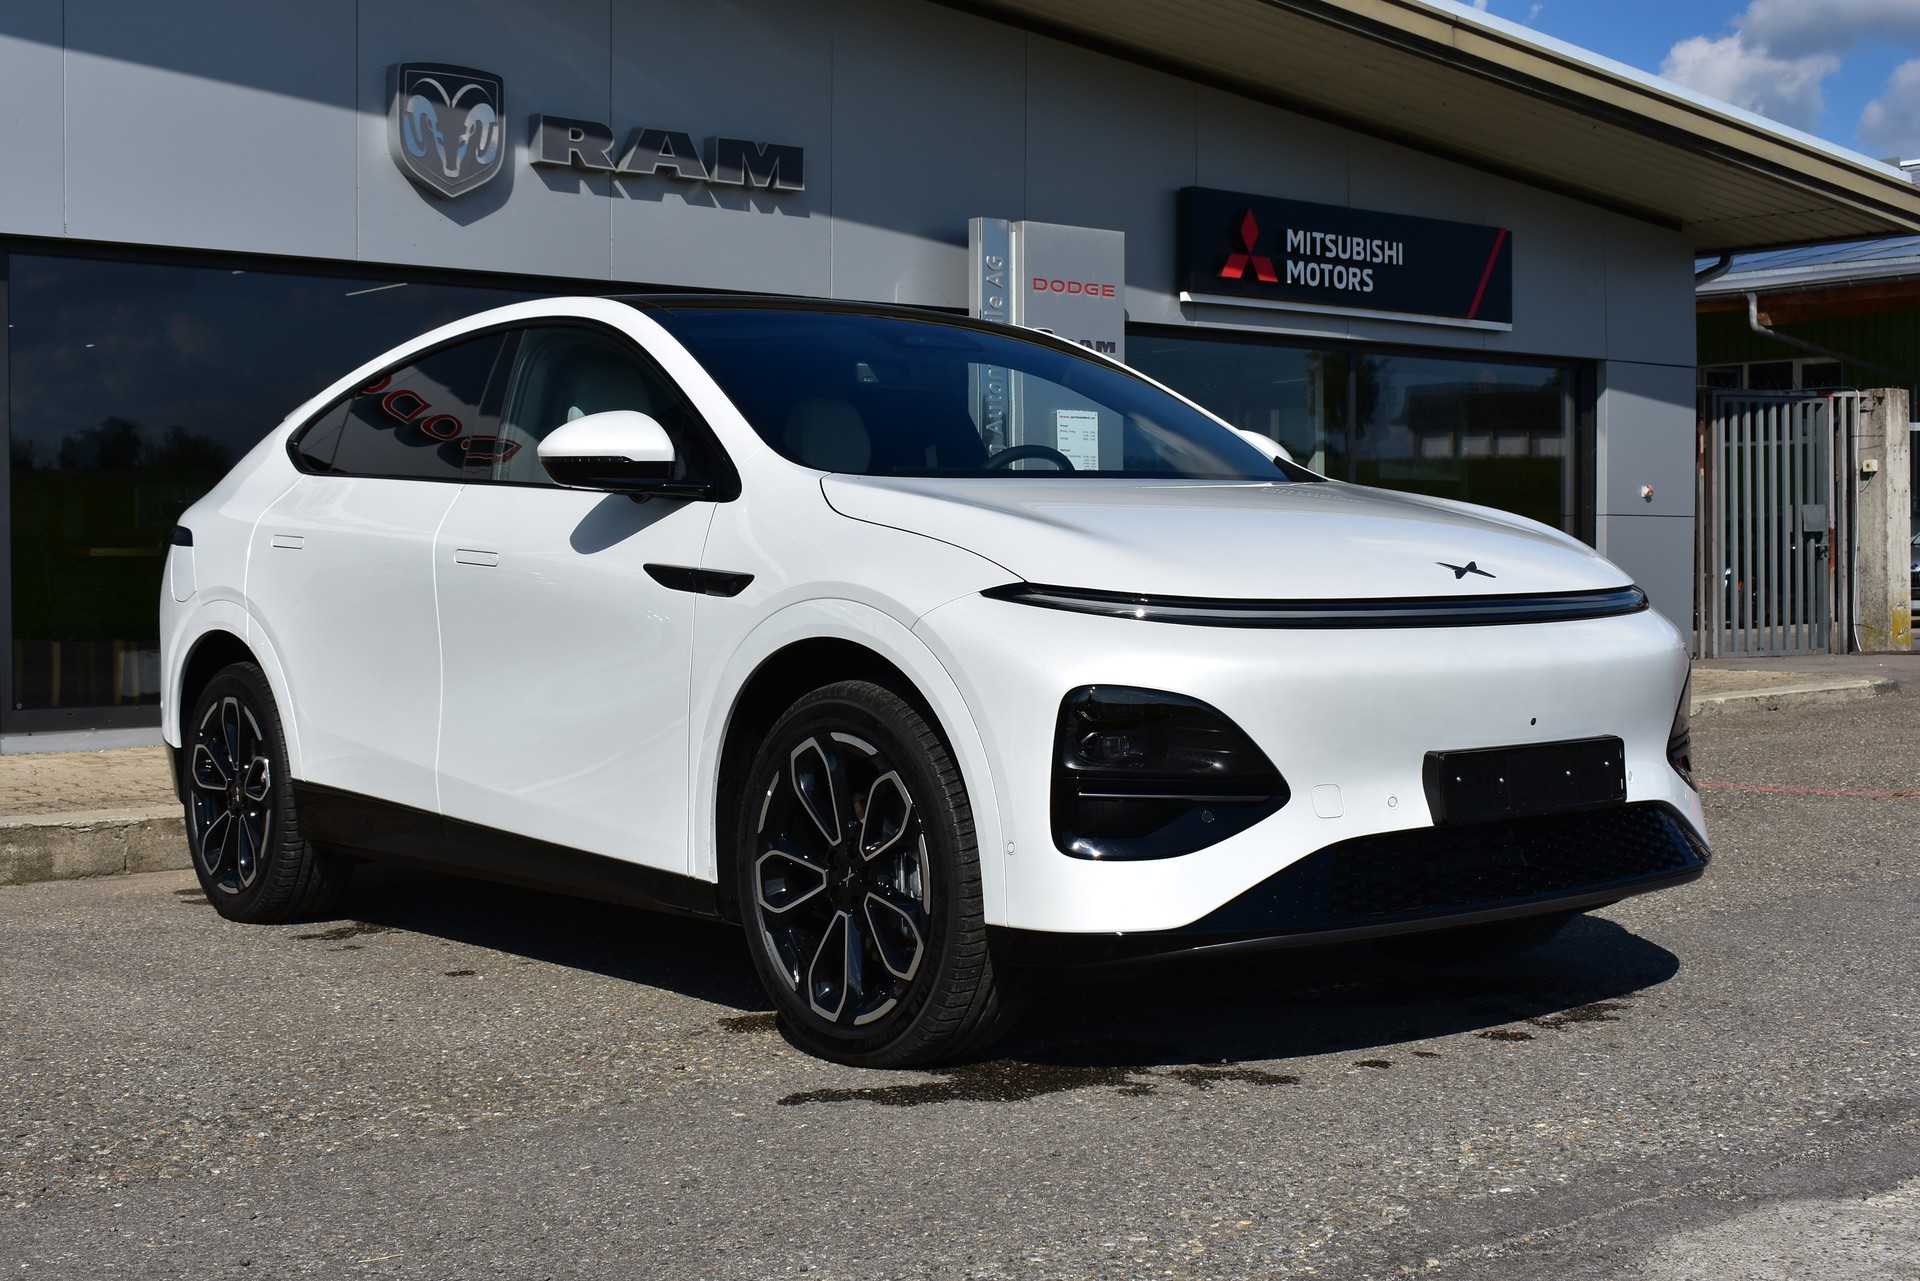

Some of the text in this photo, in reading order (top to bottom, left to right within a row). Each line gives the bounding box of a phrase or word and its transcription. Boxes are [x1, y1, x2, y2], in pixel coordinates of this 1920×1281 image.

[529, 113, 805, 191] RAM
[1286, 228, 1403, 266] MITSUBISHI
[986, 255, 1004, 289] AG
[1032, 277, 1116, 298] DODGE
[1286, 260, 1374, 293] MOTORS
[1067, 338, 1116, 354] AM
